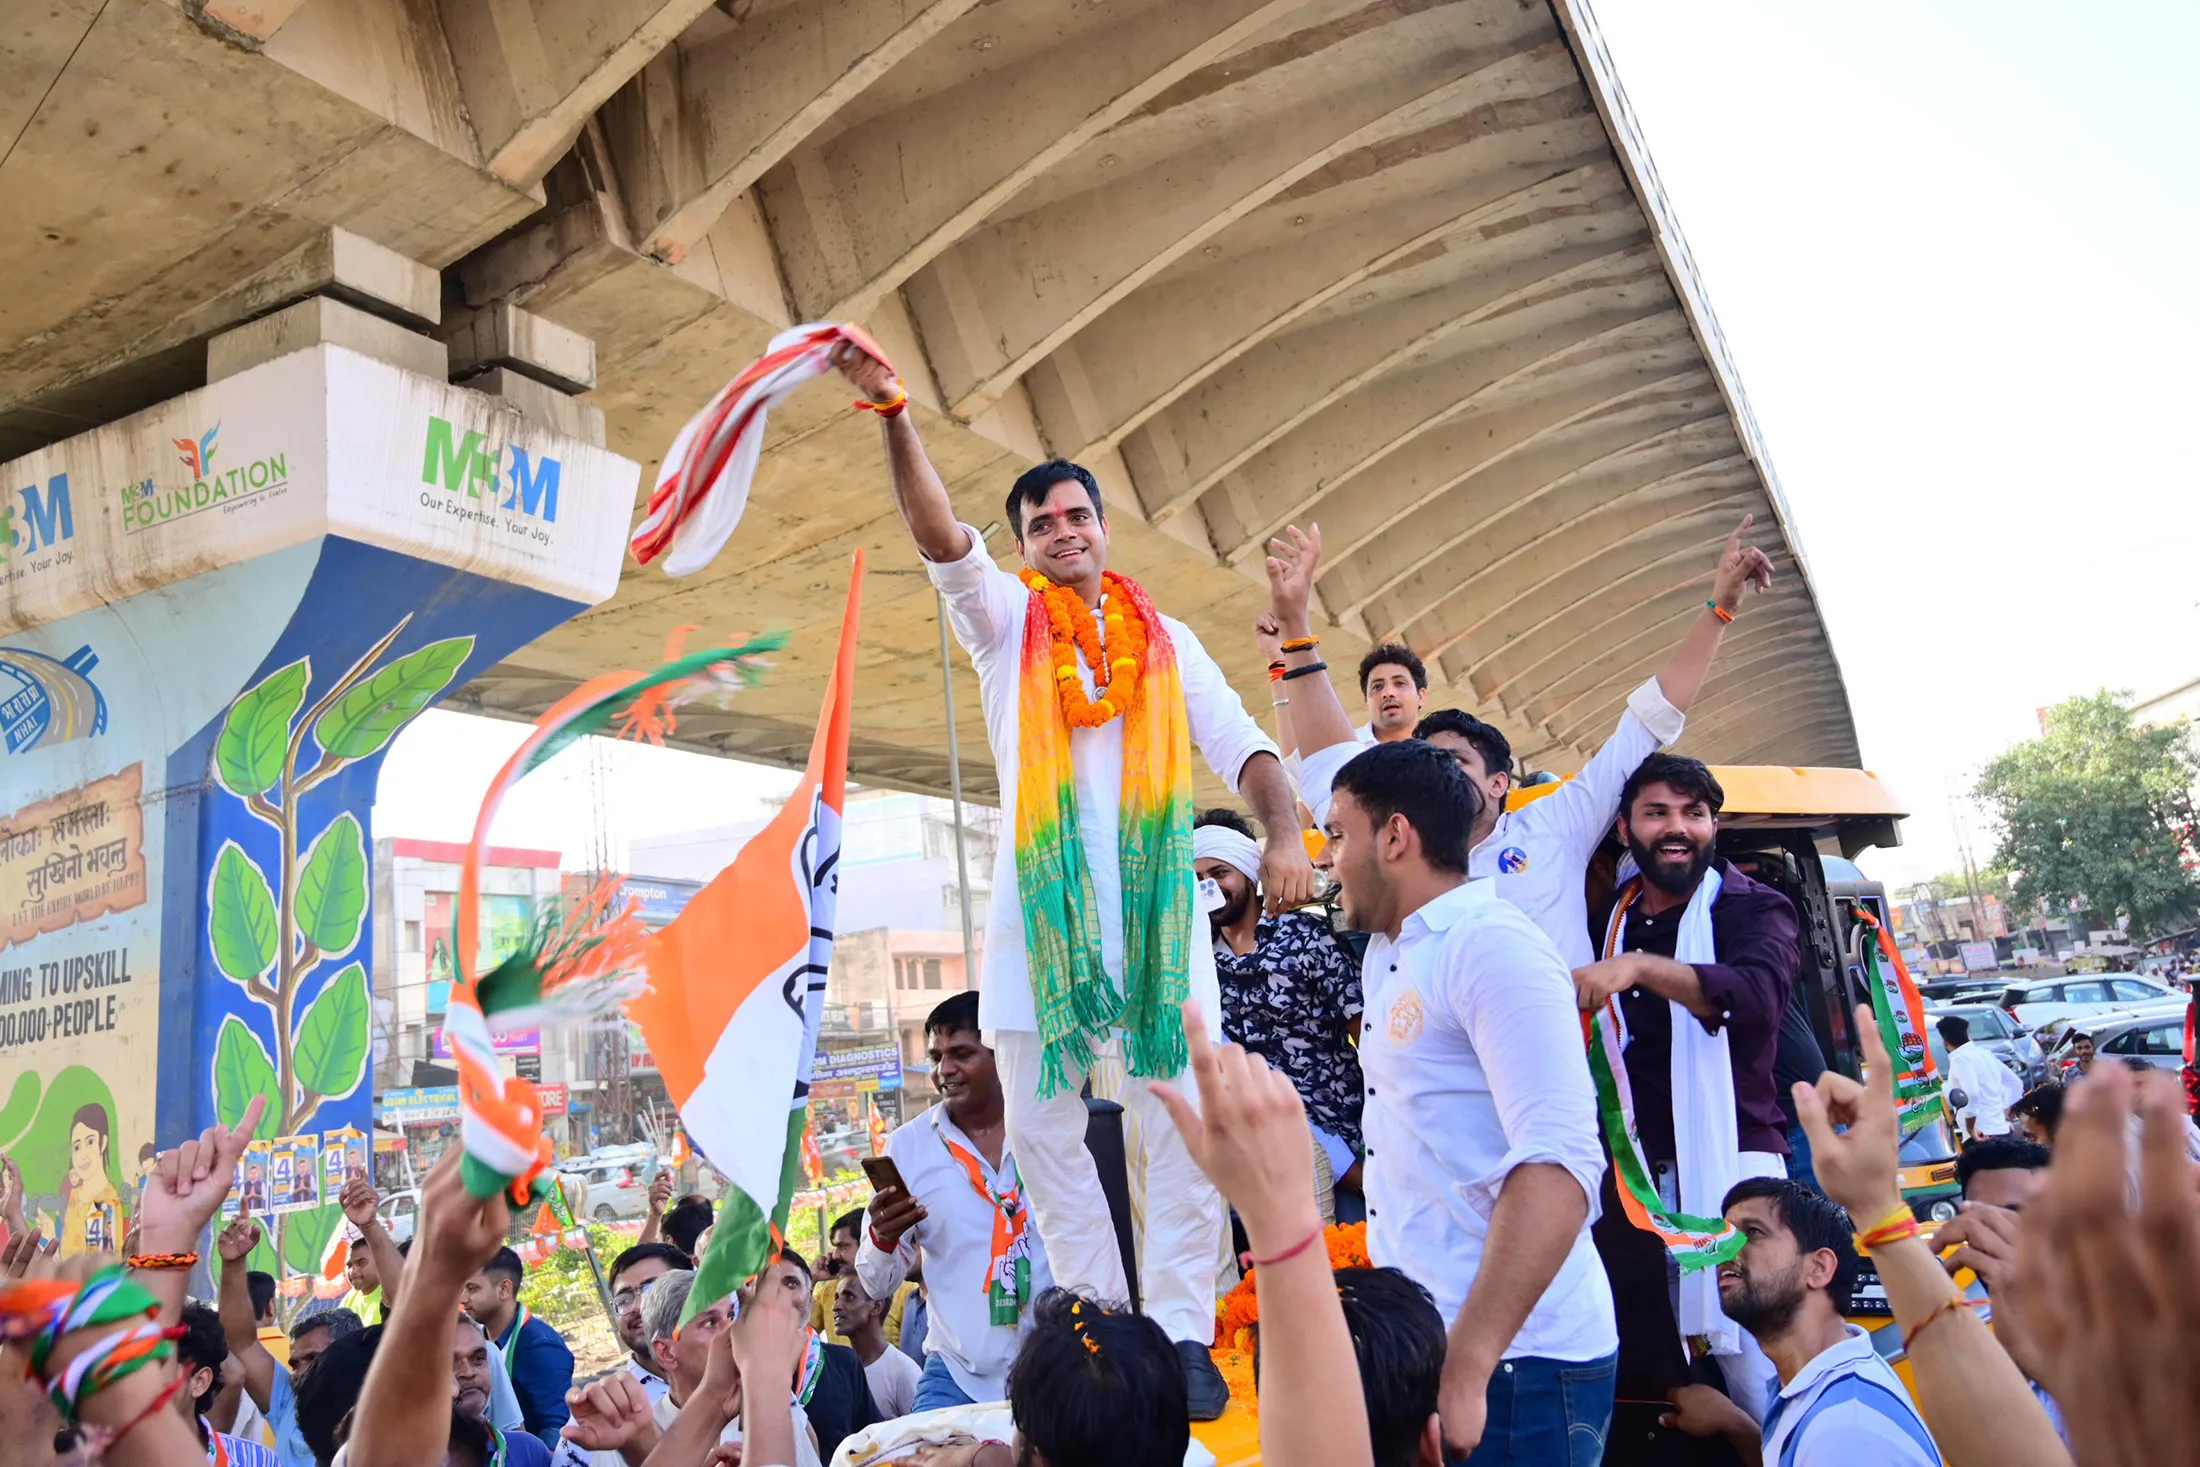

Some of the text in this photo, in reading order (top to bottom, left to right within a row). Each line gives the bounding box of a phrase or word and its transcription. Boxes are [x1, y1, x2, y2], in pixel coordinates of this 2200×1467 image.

[123, 453, 287, 531] FOUNDATION
[420, 492, 554, 546] Our Expertise. Your Joy.
[30, 558, 53, 574] Your
[14, 716, 38, 743] NHAI
[12, 909, 28, 928] LET
[74, 885, 100, 905] WORLD
[40, 961, 59, 998] TO
[63, 948, 131, 994] UPSKILL
[53, 994, 116, 1039] PEOPLE
[829, 1047, 898, 1065] DIAGNOSTICS
[276, 1158, 291, 1178] 4
[328, 1149, 342, 1169] 4
[88, 1218, 102, 1239] 4
